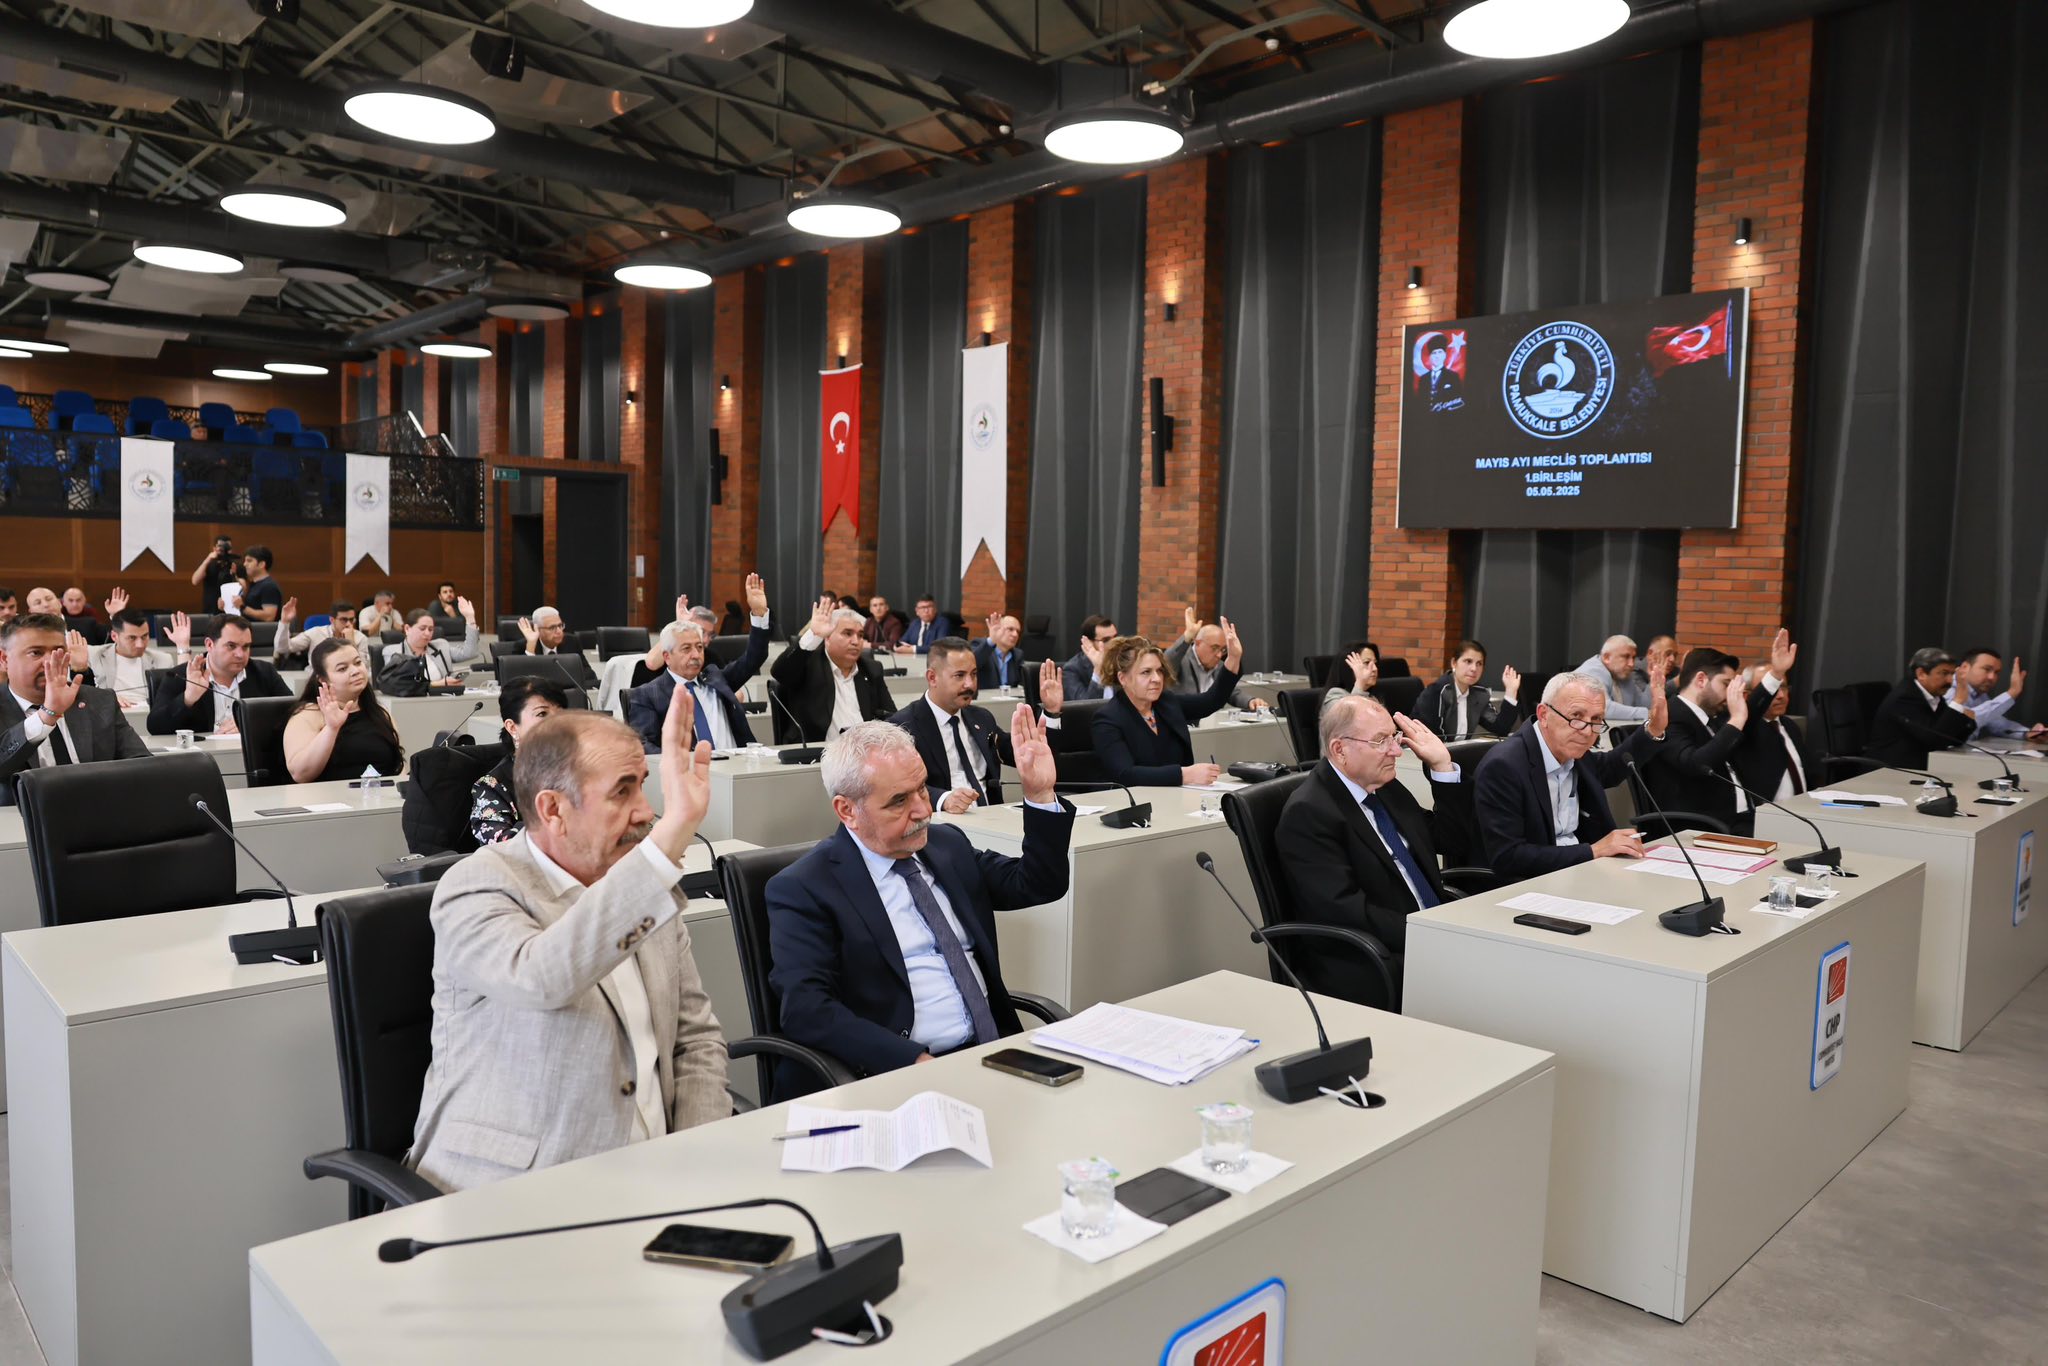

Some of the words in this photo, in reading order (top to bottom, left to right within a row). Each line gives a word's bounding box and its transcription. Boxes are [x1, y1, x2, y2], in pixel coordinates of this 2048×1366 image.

[1508, 331, 1544, 376] TÜRKİYE
[1545, 325, 1611, 369] CUMHURİYETİ
[1509, 384, 1558, 432] PAMUKKALE
[1475, 457, 1510, 469] MAYIS
[1511, 456, 1531, 467] AYI
[1532, 453, 1577, 467] MECLİS
[1579, 452, 1652, 466] TOPLANTISI
[1526, 486, 1580, 496] 05.05.2025
[1825, 1013, 1841, 1039] CHP
